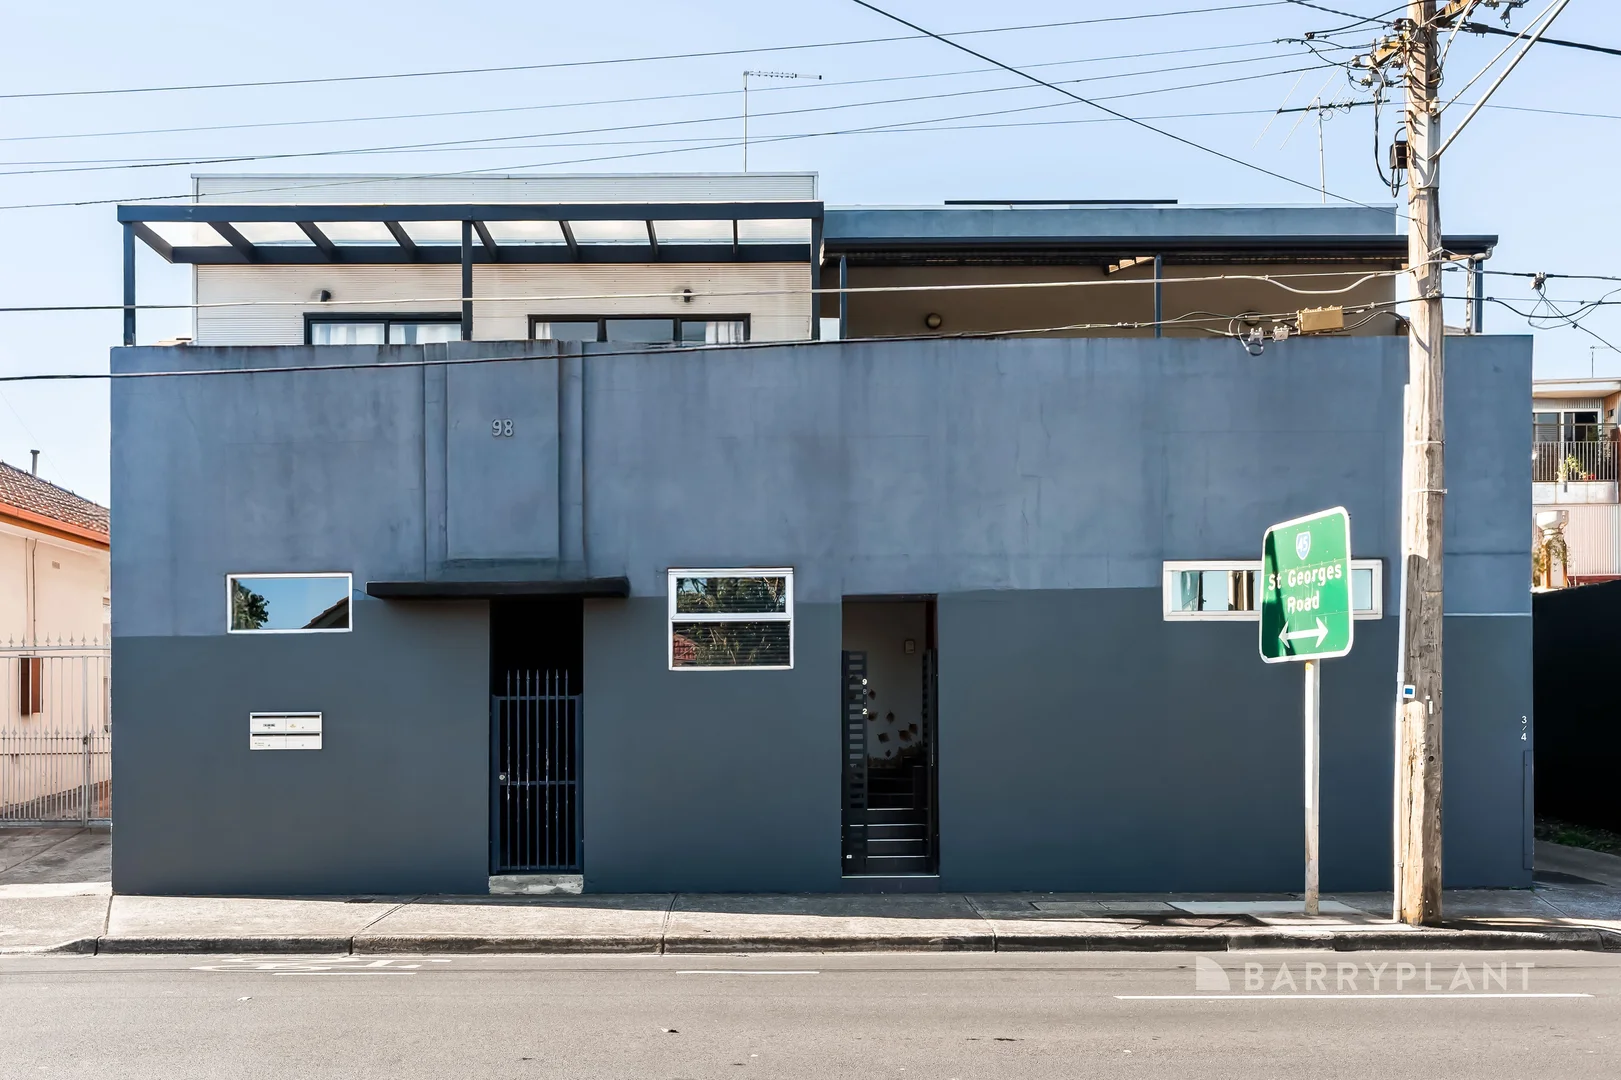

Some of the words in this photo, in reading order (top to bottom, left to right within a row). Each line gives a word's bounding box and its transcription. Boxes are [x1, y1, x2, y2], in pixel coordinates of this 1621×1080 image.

[492, 419, 514, 437] 98
[1297, 535, 1309, 553] 45
[1268, 572, 1282, 590] St
[1287, 563, 1342, 587] Georges
[1287, 590, 1320, 614] Road
